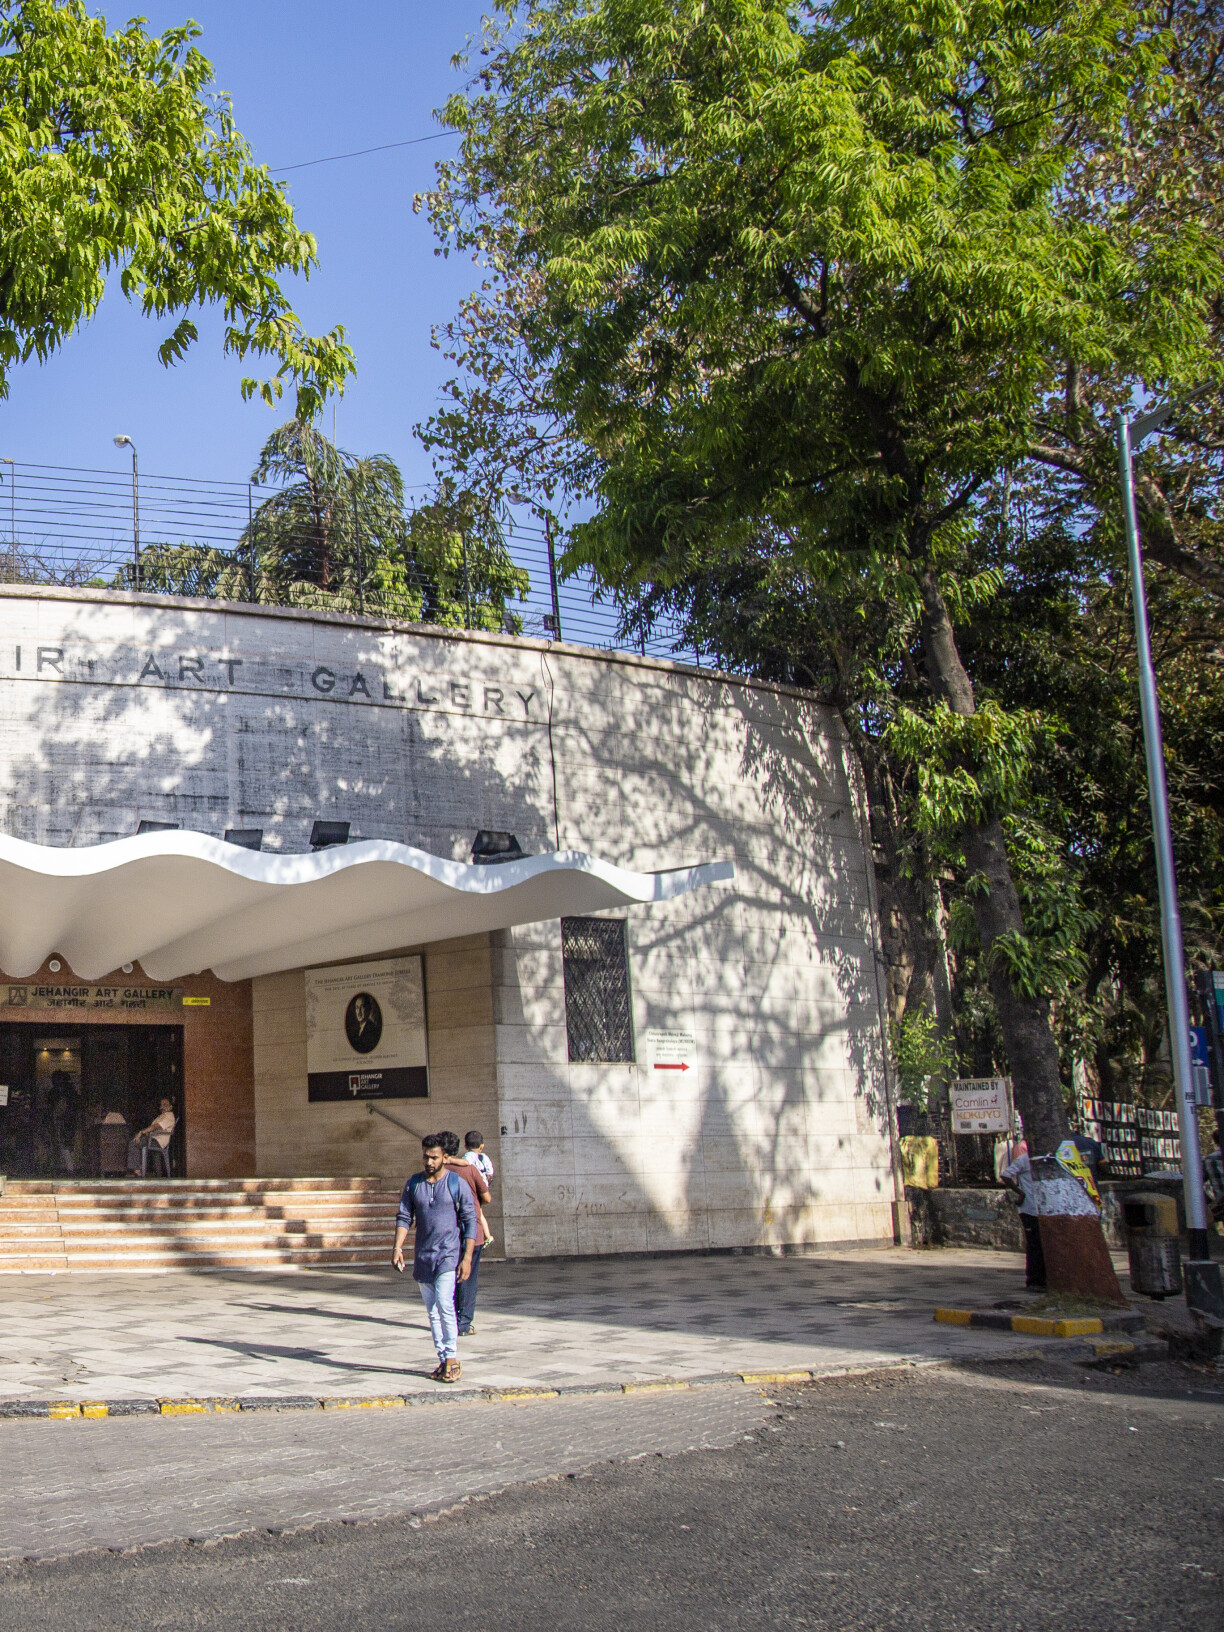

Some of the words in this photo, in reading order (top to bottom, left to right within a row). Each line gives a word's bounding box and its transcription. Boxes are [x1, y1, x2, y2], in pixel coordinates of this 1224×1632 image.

[139, 654, 243, 686] ART
[311, 666, 536, 717] GALLERY
[31, 986, 90, 997] JEHANGIR
[95, 988, 119, 998] ART
[123, 988, 174, 999] GALLERY
[953, 1081, 990, 1091] MAINTAINED
[990, 1081, 999, 1090] BY
[955, 1097, 989, 1108] Camlin
[956, 1110, 1001, 1120] KOKUYO
